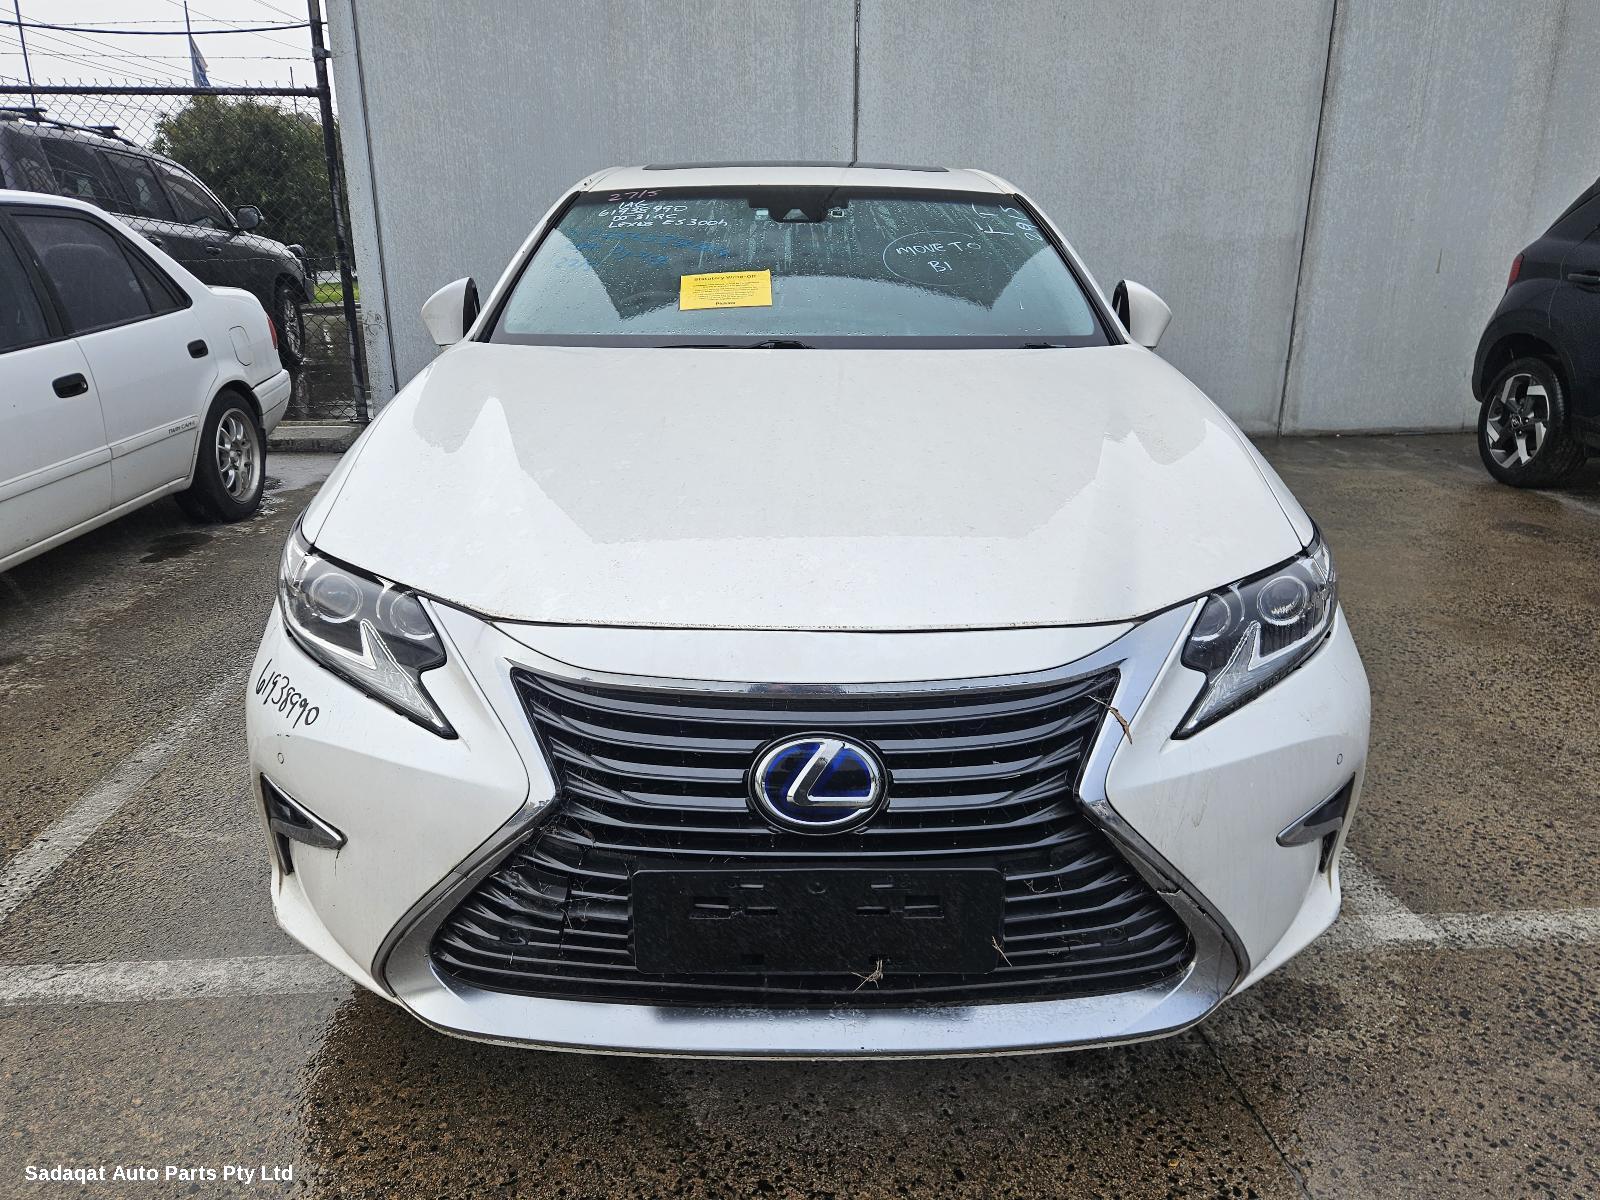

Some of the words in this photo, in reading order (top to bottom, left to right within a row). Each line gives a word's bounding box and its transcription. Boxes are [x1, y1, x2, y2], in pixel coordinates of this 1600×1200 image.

[895, 243, 946, 256] MOVE
[947, 241, 981, 252] TO
[255, 658, 320, 729] 61938990
